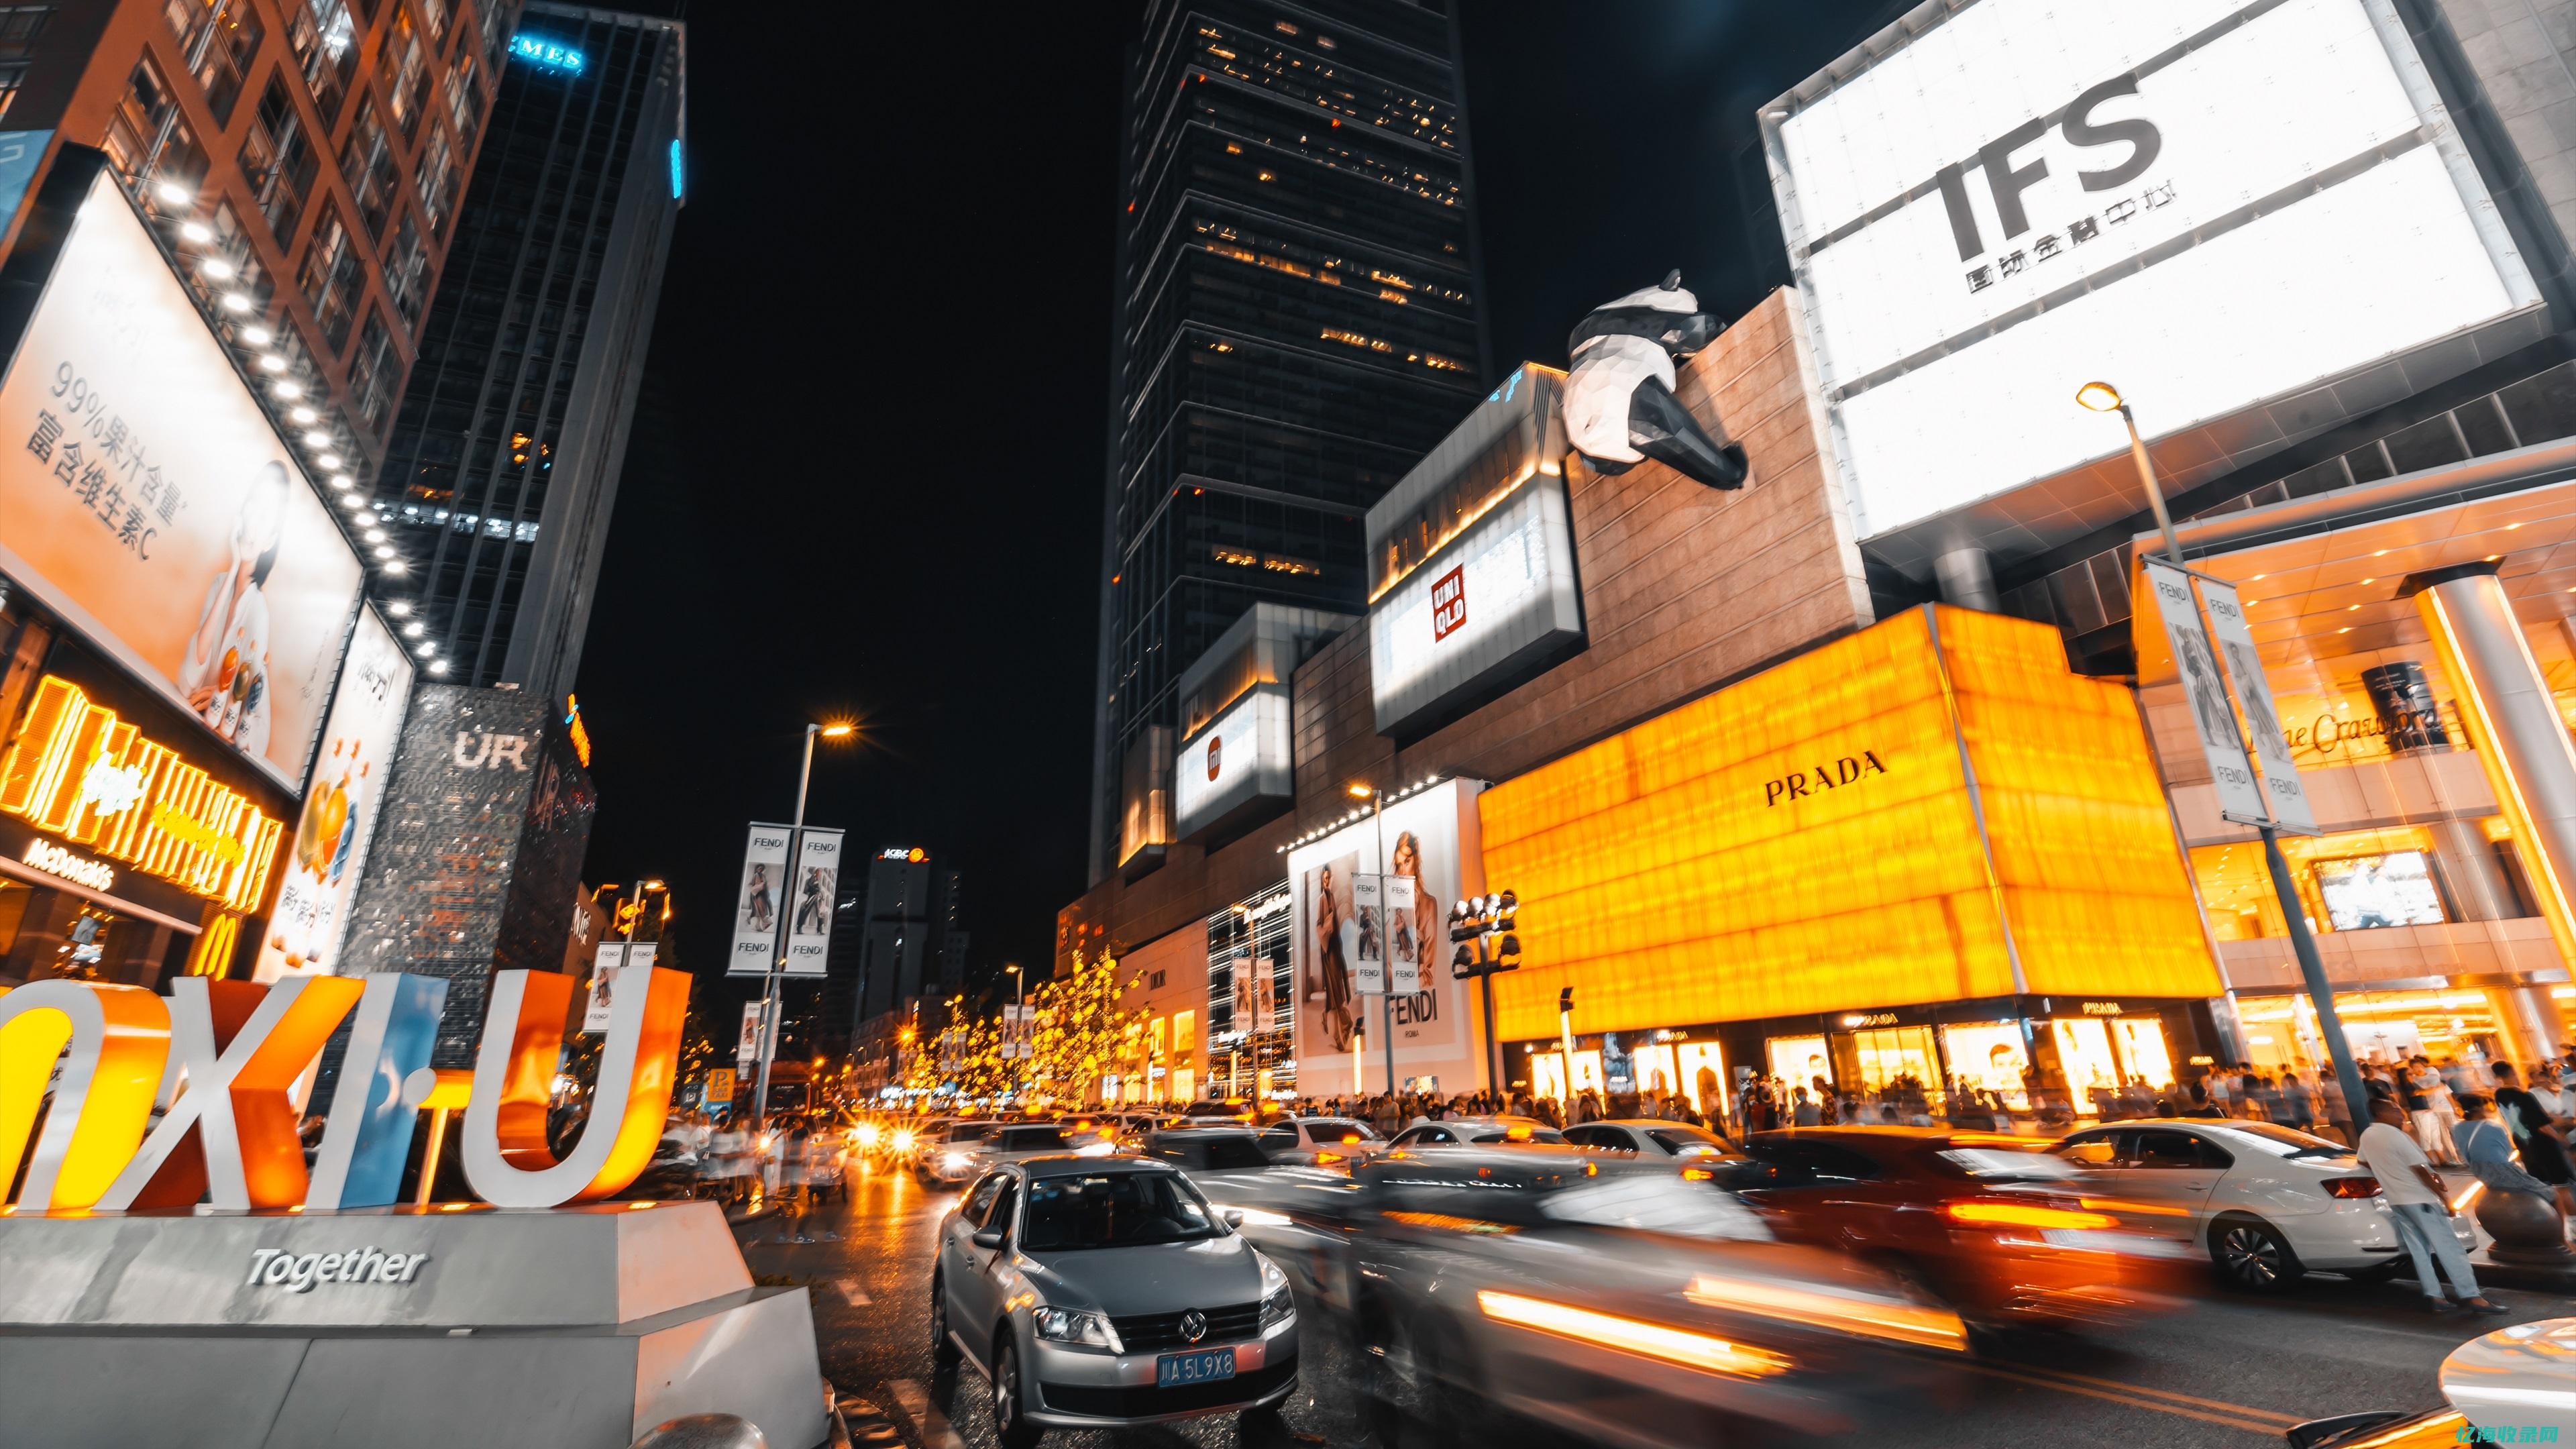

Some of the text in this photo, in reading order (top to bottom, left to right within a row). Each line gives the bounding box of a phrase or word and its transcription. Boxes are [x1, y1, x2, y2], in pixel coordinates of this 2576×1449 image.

[1936, 72, 2161, 263] IFS
[27, 407, 158, 561] 富含维生素C
[1433, 574, 1460, 610] UNI
[2158, 581, 2190, 602] FENDI
[1435, 598, 1464, 636] QLO
[2210, 598, 2241, 619] FENDI
[455, 731, 529, 770] UR
[1765, 750, 1889, 808] PRADA
[2217, 766, 2252, 785] FENDI
[2269, 777, 2302, 796] FENDI
[754, 837, 784, 847] FENDI
[807, 842, 837, 852] FENDI
[1357, 884, 1377, 892] FENDI
[738, 943, 769, 952] FENDI
[794, 945, 823, 955] FENDI
[1360, 969, 1380, 977] FENDI
[1395, 970, 1415, 978] FENDI
[2082, 1002, 2123, 1016] PRADA
[246, 1245, 429, 1293] Together
